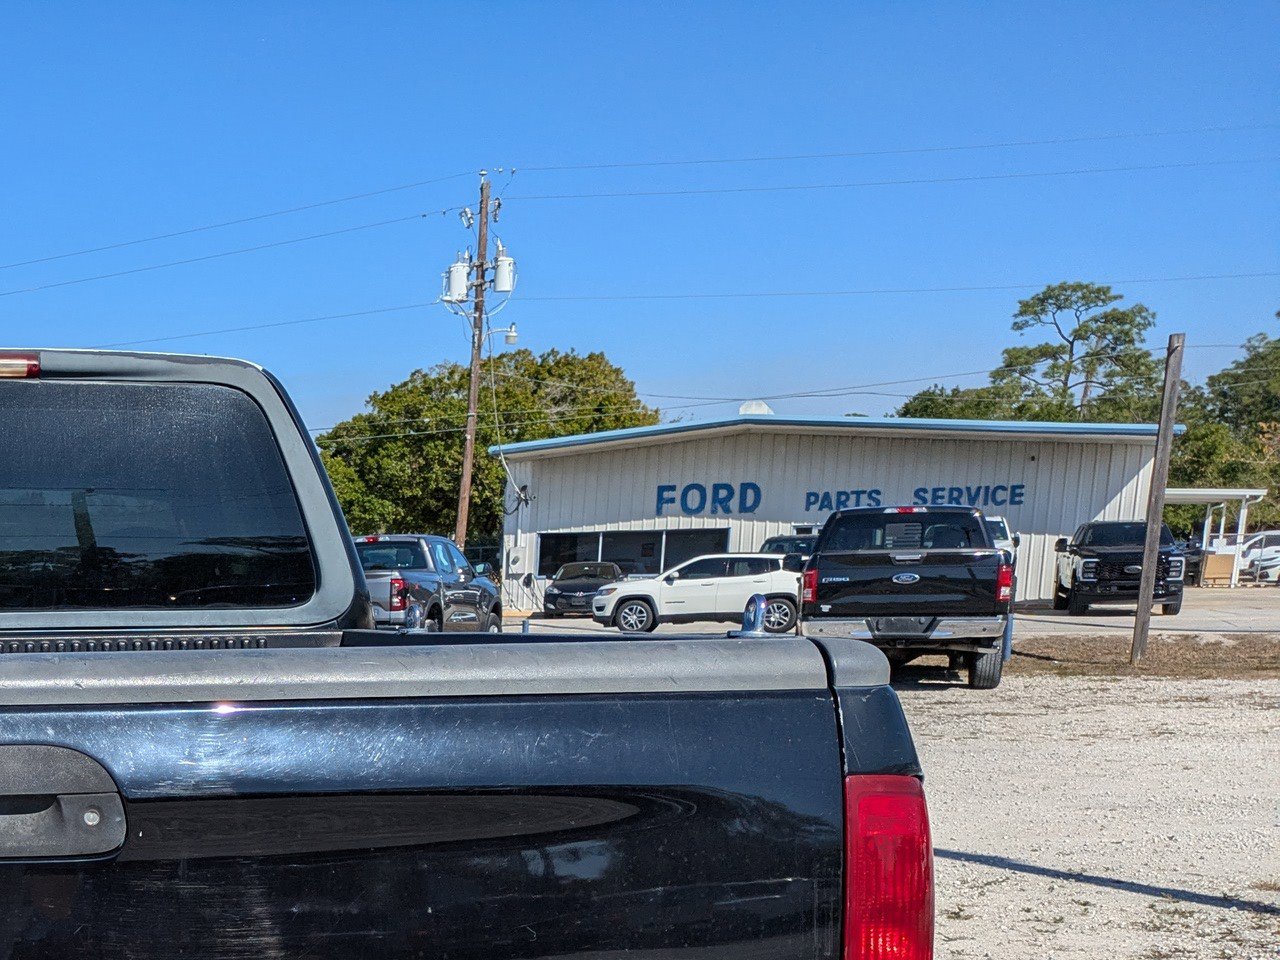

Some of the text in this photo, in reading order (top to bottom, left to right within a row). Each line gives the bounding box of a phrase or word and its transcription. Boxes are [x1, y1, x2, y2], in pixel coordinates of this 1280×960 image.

[656, 482, 1025, 516] FORD PARTS SERVICE
